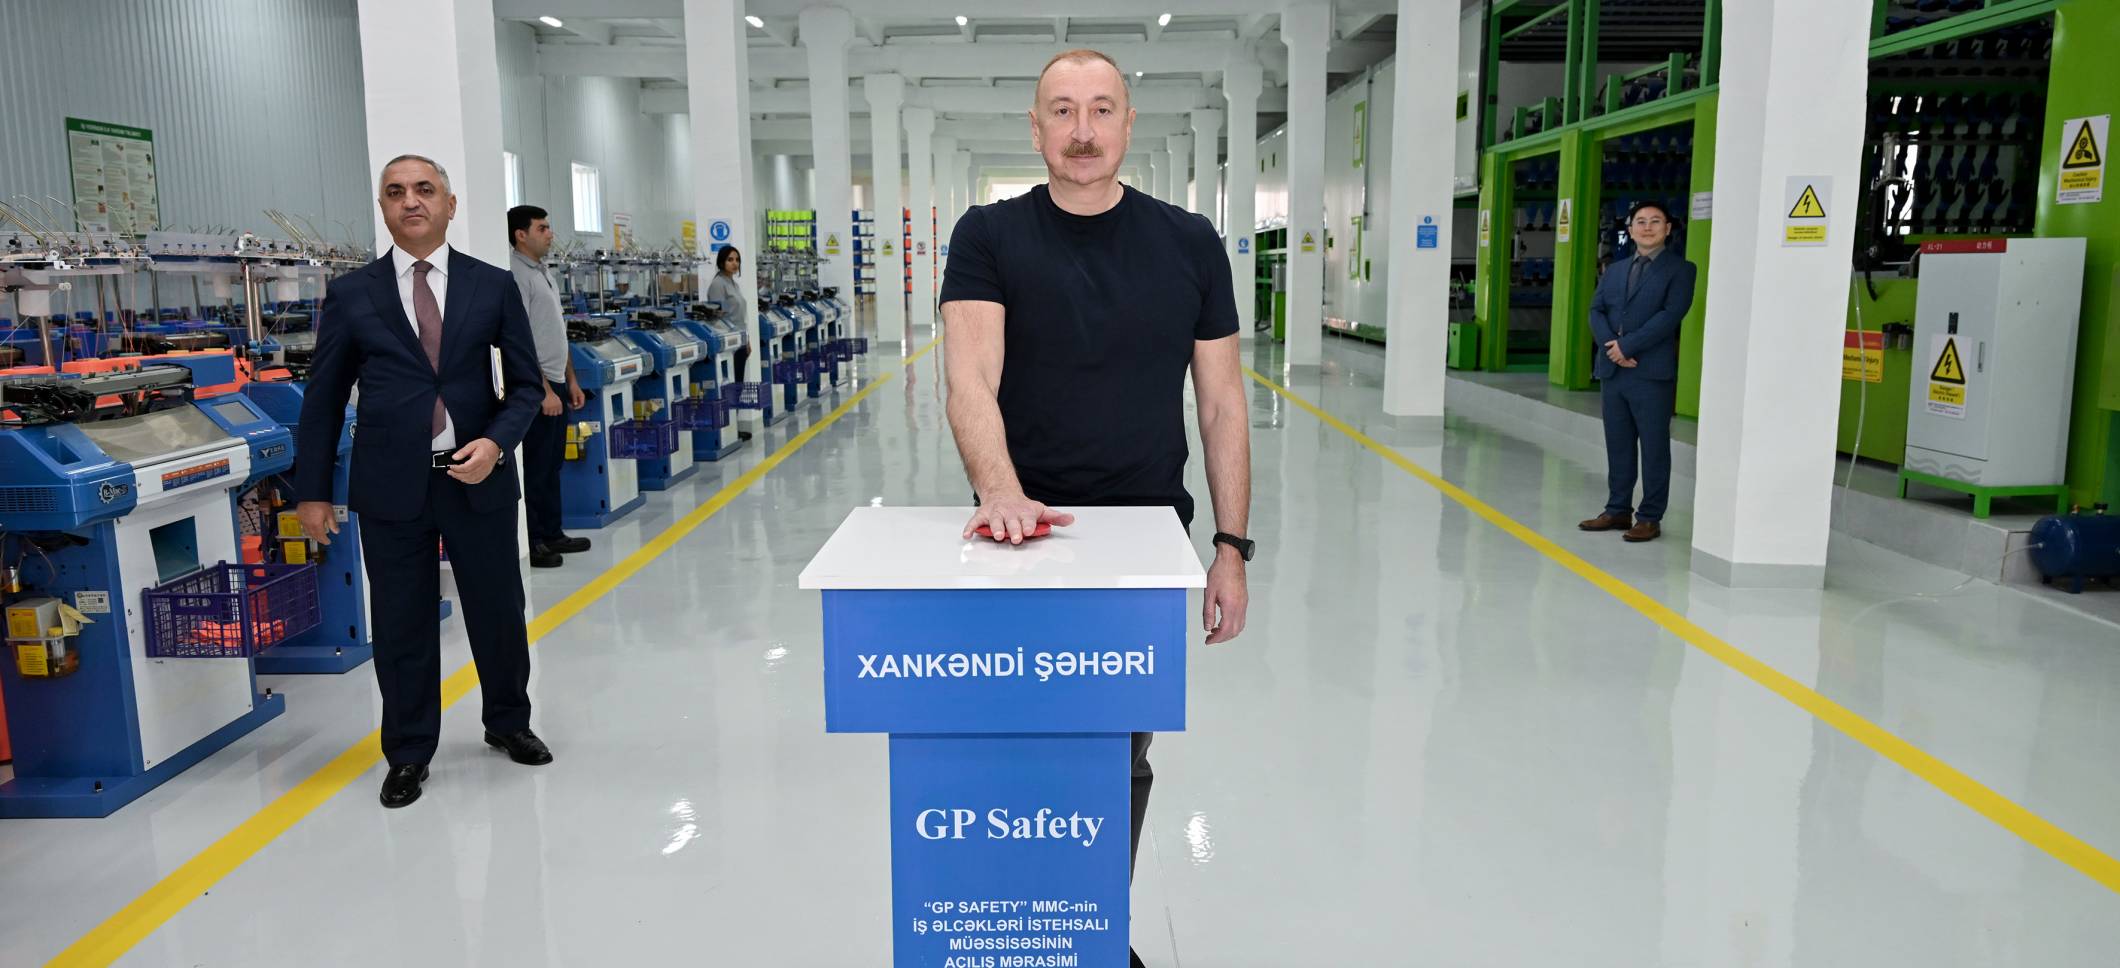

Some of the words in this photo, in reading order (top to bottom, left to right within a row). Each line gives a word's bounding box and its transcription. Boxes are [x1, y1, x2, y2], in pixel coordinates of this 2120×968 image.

[857, 646, 1024, 678] XANKƏNDİ
[1034, 645, 1154, 681] ŞƏHƏRİ
[915, 808, 977, 840] GP
[987, 807, 1105, 848] Safety
[1032, 900, 1098, 912] MMC-nin
[913, 918, 928, 935] İŞ
[932, 917, 1023, 932] ƏLCƏKLƏRİ
[1027, 917, 1109, 931] İSTEHSALI
[949, 934, 1073, 951] MÜƏSSİSƏSİNİN
[1000, 953, 1078, 968] MƏRASİMİ
